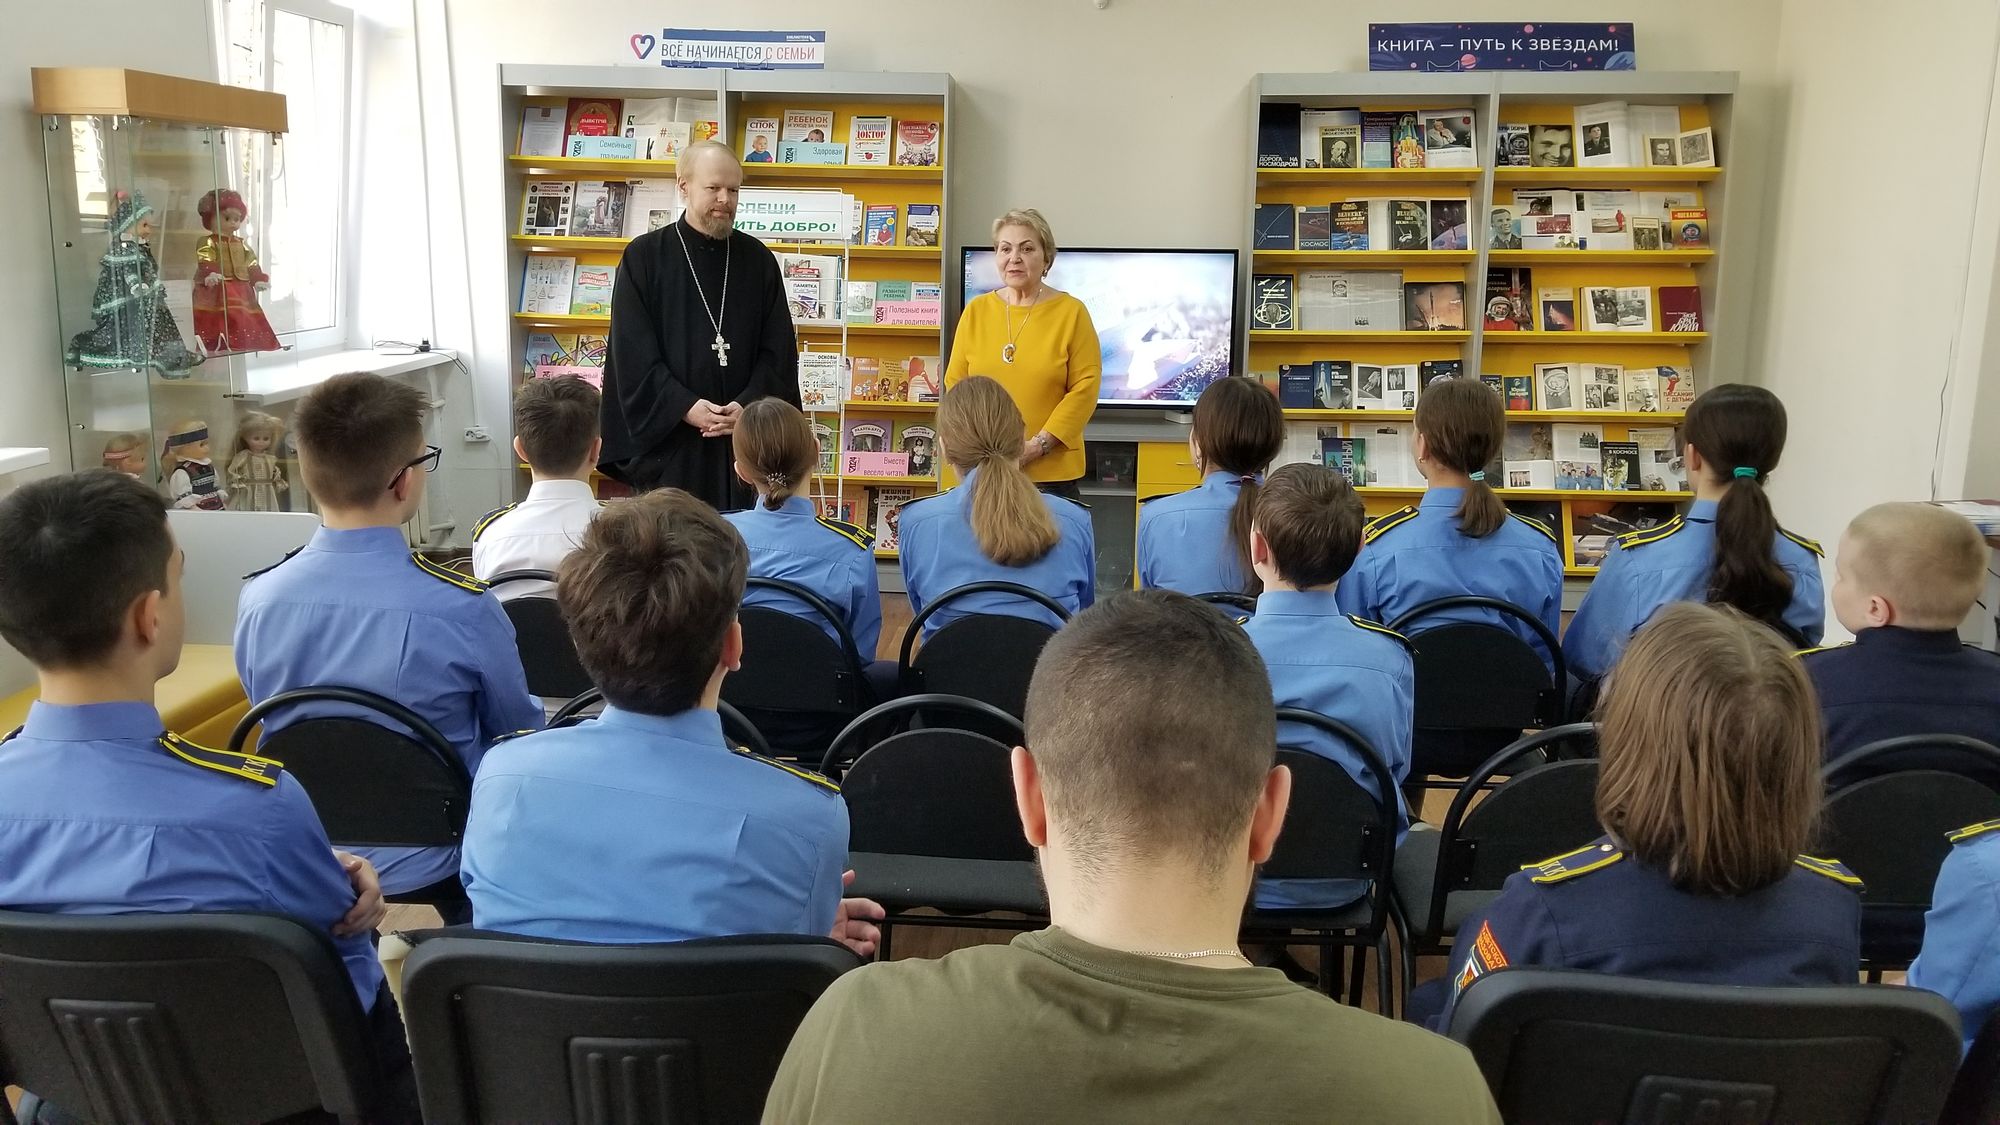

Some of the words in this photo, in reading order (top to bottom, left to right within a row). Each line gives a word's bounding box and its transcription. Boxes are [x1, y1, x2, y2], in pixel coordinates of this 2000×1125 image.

[1377, 39, 1435, 51] КНИГА
[1460, 38, 1506, 51] ПУТЬ
[1512, 38, 1523, 50] К
[661, 41, 683, 57] ВСЁ
[686, 44, 762, 60] НАЧИНАЕТСЯ
[765, 47, 773, 60] С
[776, 47, 816, 60] СЕМЬИ
[788, 115, 829, 124] РЕБЕНОК
[599, 140, 632, 149] Семейные
[812, 146, 843, 156] Здоровая
[737, 202, 796, 214] СПЕШИ
[734, 220, 766, 231] ИТЬ
[770, 220, 836, 233] ДОБРО!
[889, 305, 920, 314] Полезные
[920, 306, 938, 314] книги
[904, 317, 937, 325] родителей
[883, 456, 905, 465] Вместе
